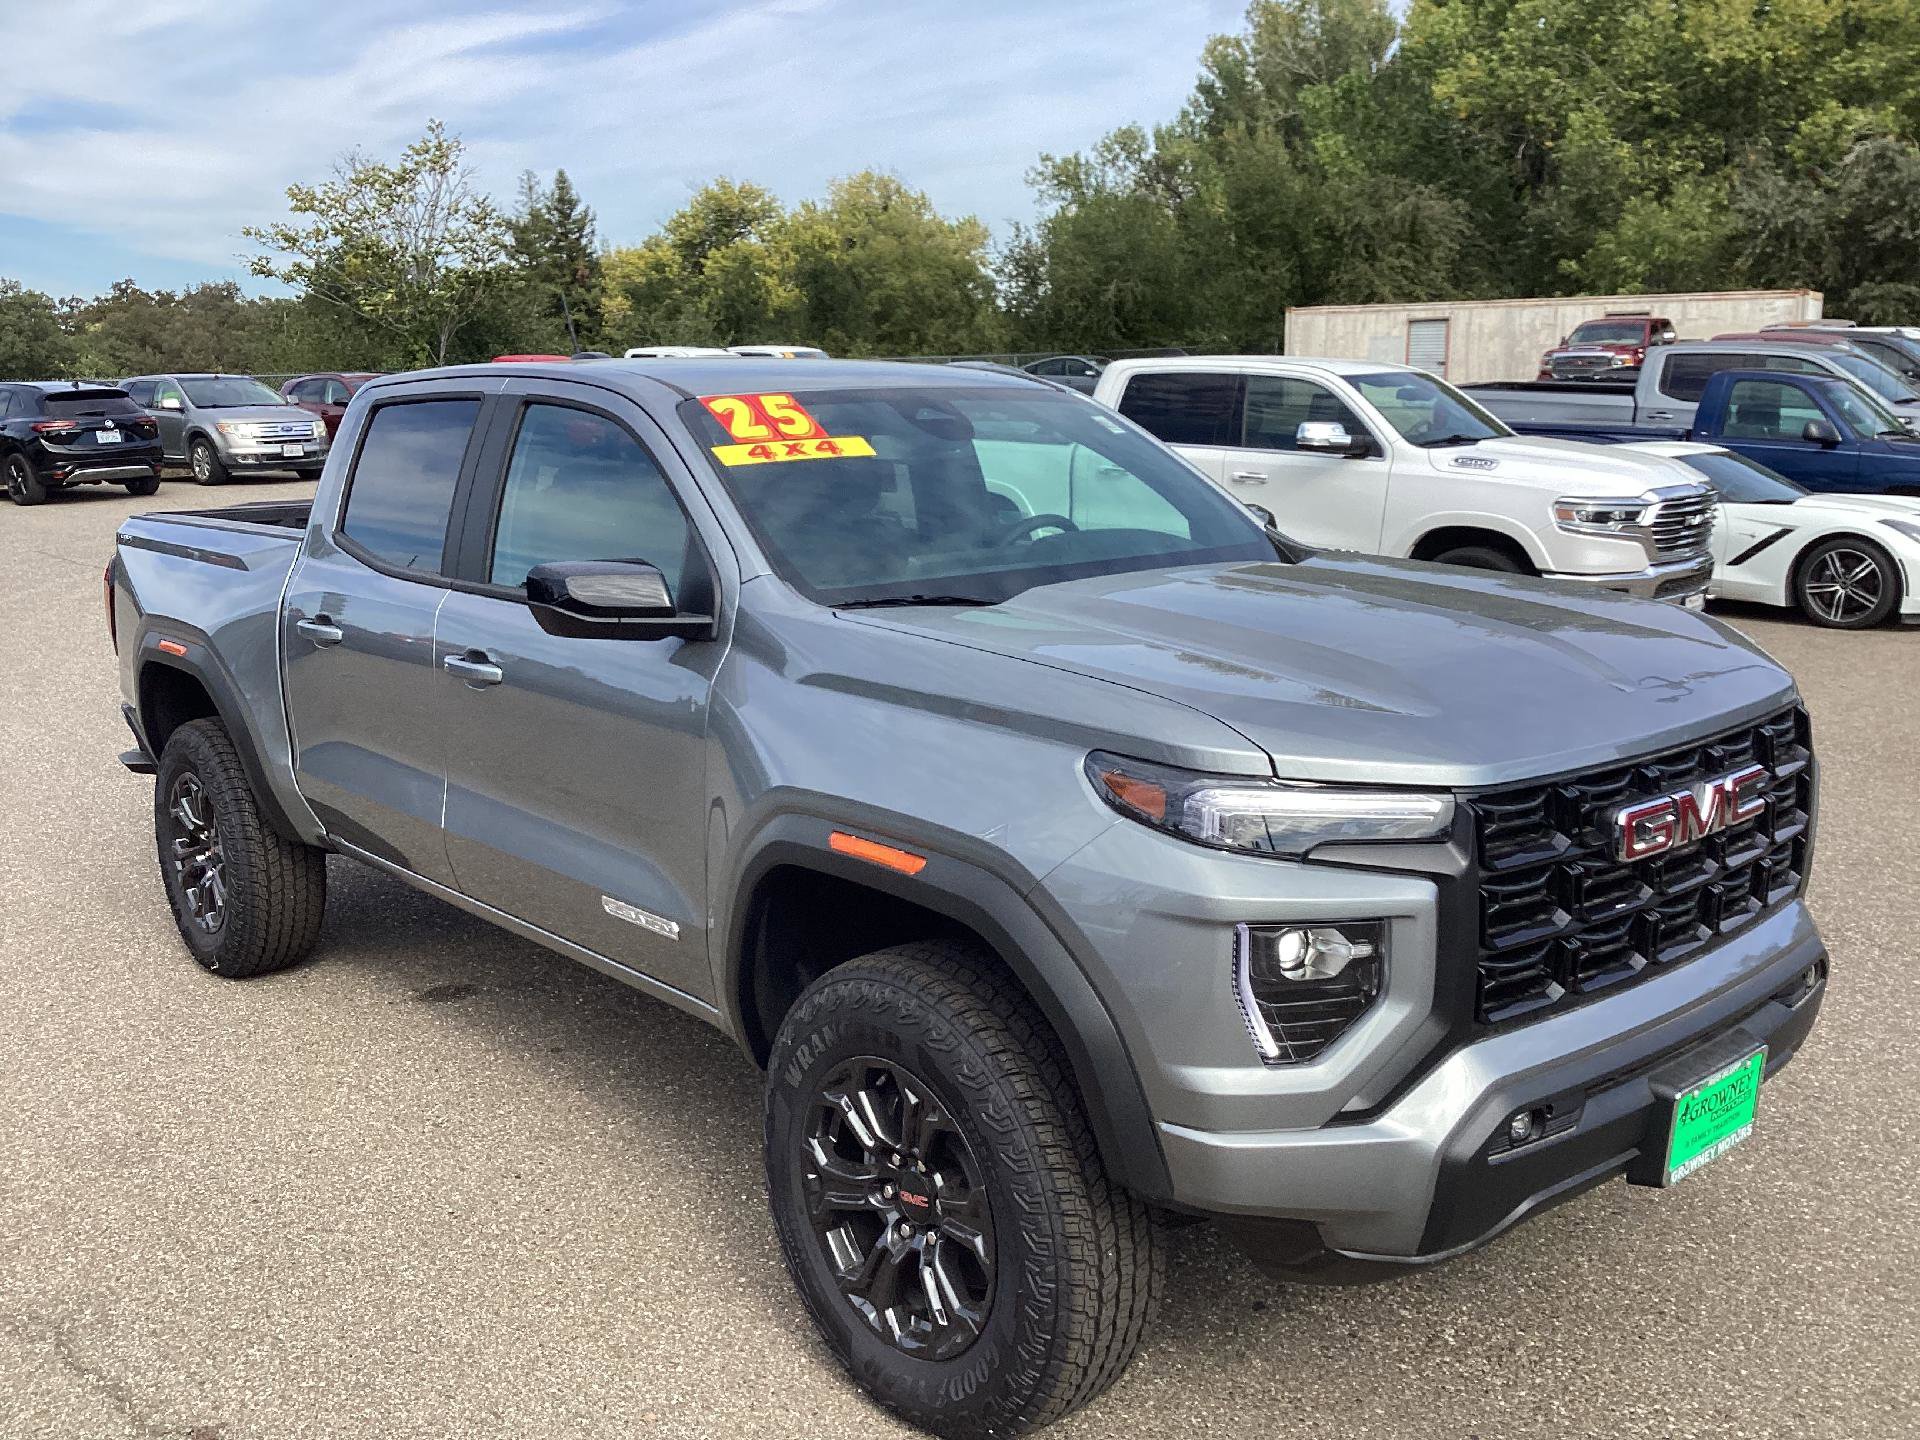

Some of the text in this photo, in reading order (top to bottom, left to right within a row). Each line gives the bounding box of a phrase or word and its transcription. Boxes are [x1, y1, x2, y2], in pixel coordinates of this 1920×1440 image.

[709, 395, 812, 438] 25
[1617, 763, 1770, 862] GMC
[1689, 1071, 1754, 1121] GROWNEY
[899, 1190, 928, 1207] GMC
